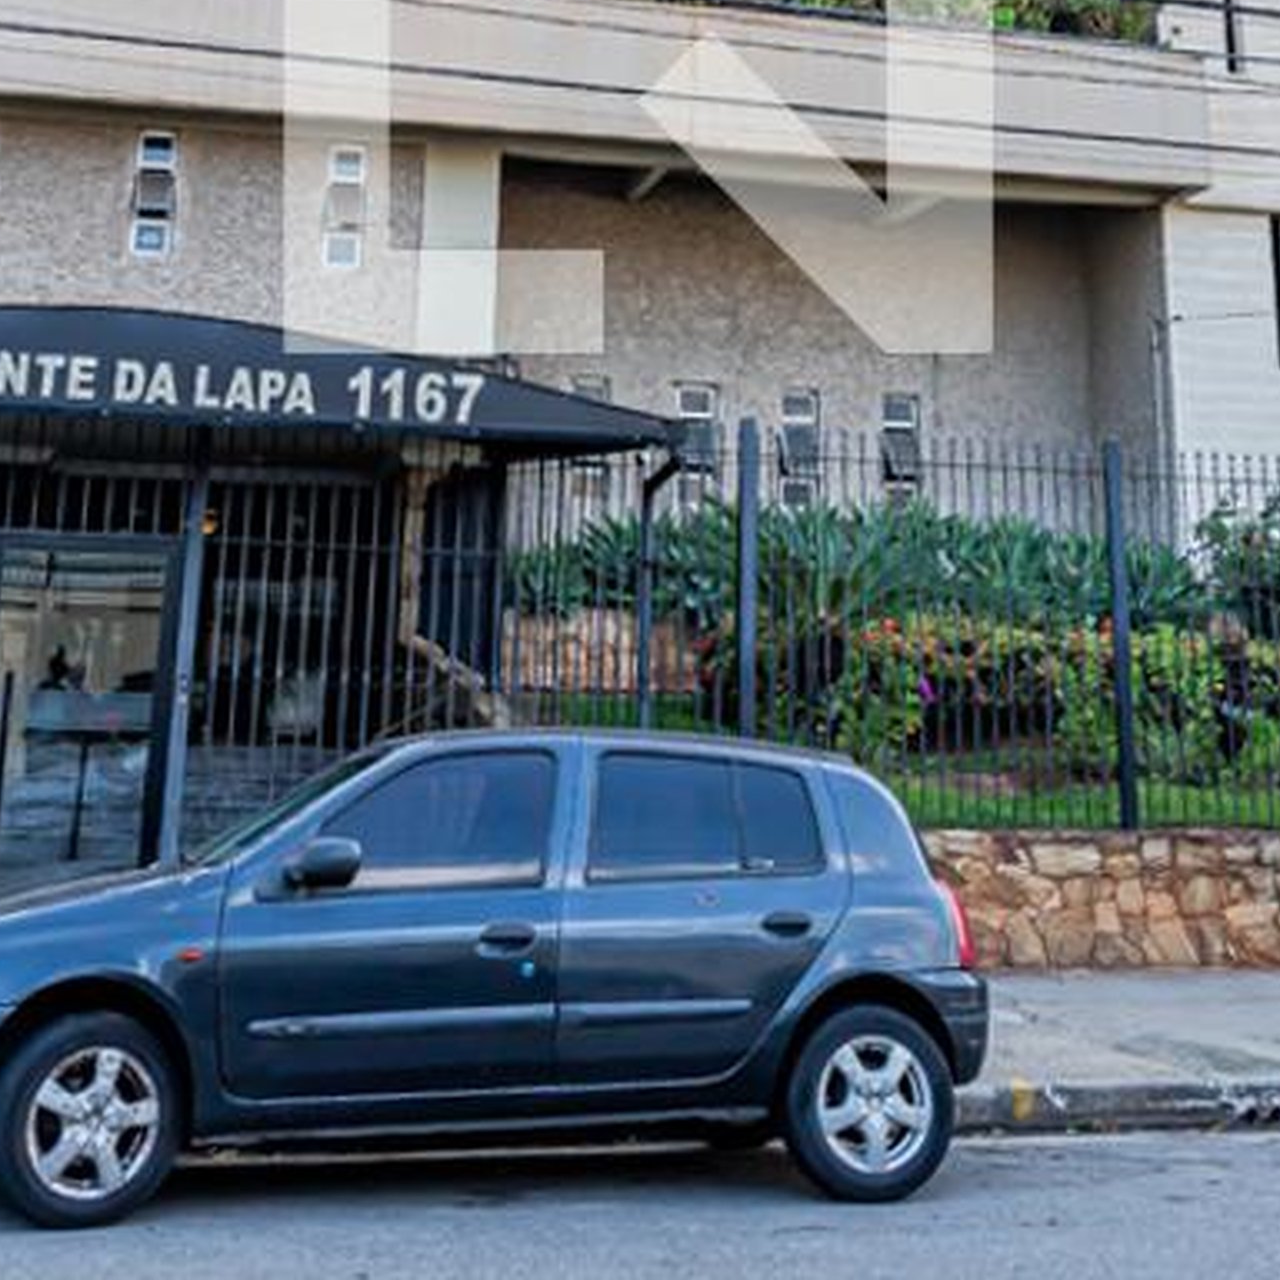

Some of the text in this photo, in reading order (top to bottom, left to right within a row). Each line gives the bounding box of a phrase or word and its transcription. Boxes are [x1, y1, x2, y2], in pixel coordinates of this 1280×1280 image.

[113, 359, 178, 406] DA
[194, 365, 316, 415] LAPA
[349, 366, 485, 424] 1167
